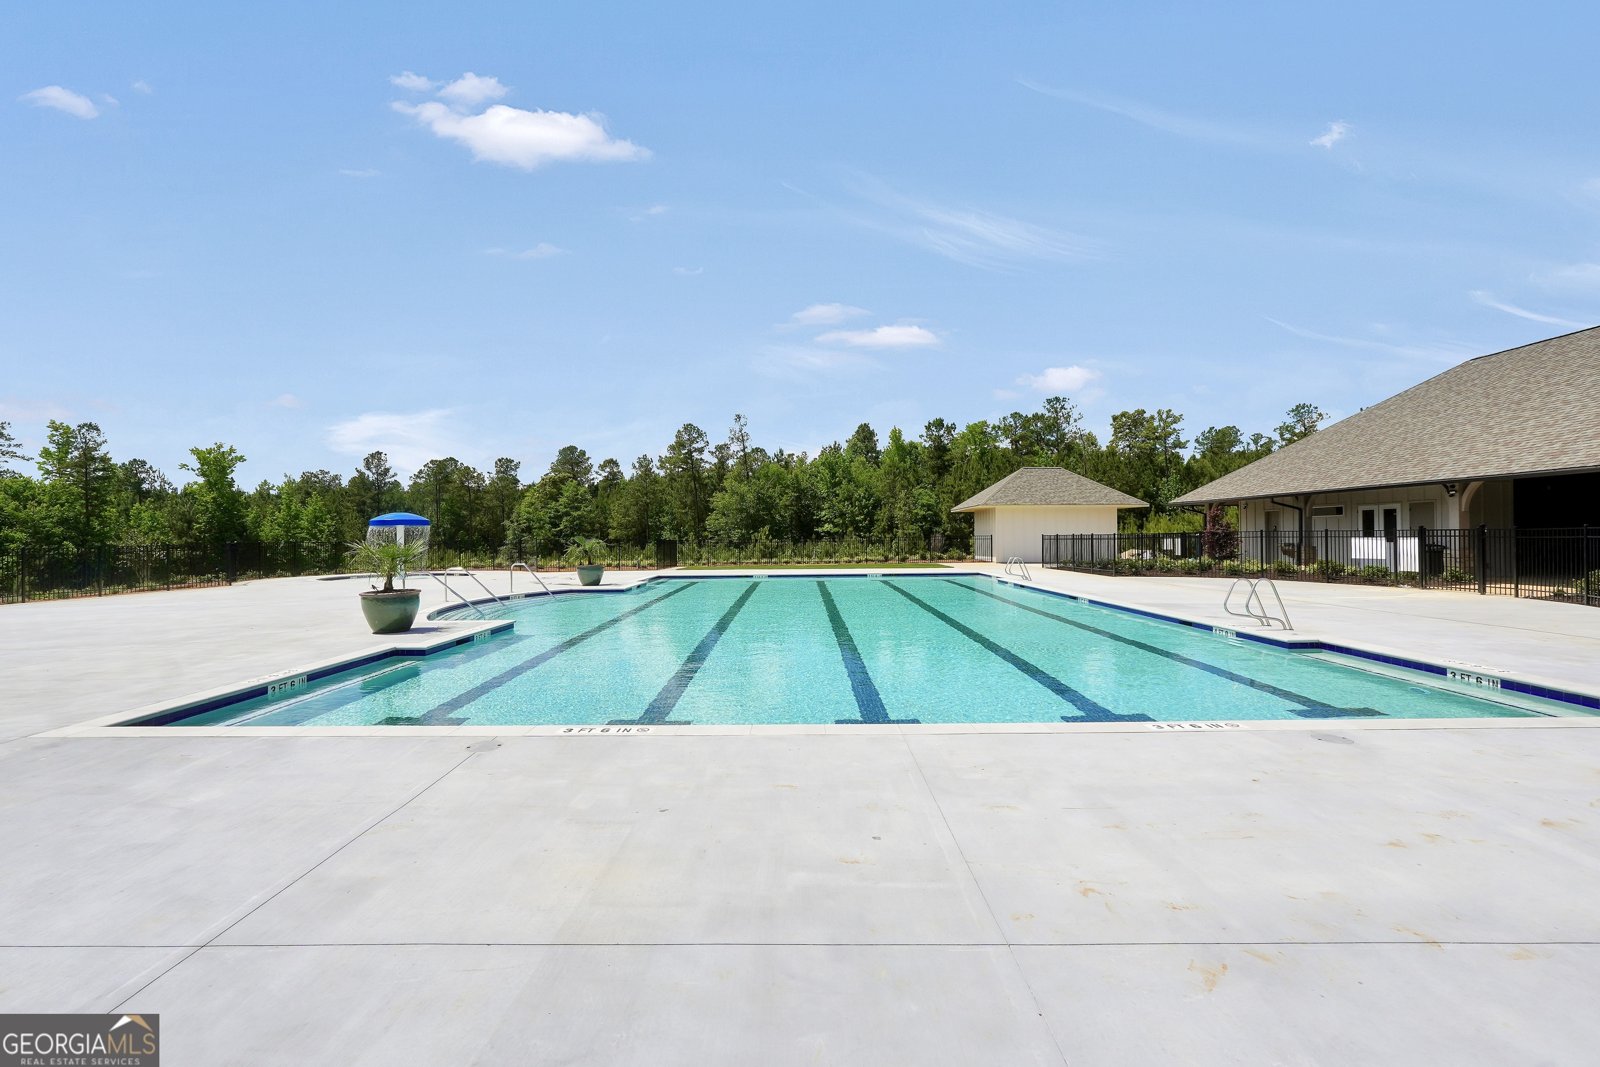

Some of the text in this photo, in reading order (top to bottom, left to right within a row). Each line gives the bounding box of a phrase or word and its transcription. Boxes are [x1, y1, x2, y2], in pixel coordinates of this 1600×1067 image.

[298, 676, 306, 685] IN
[1460, 672, 1472, 681] FT
[1487, 678, 1499, 688] IN
